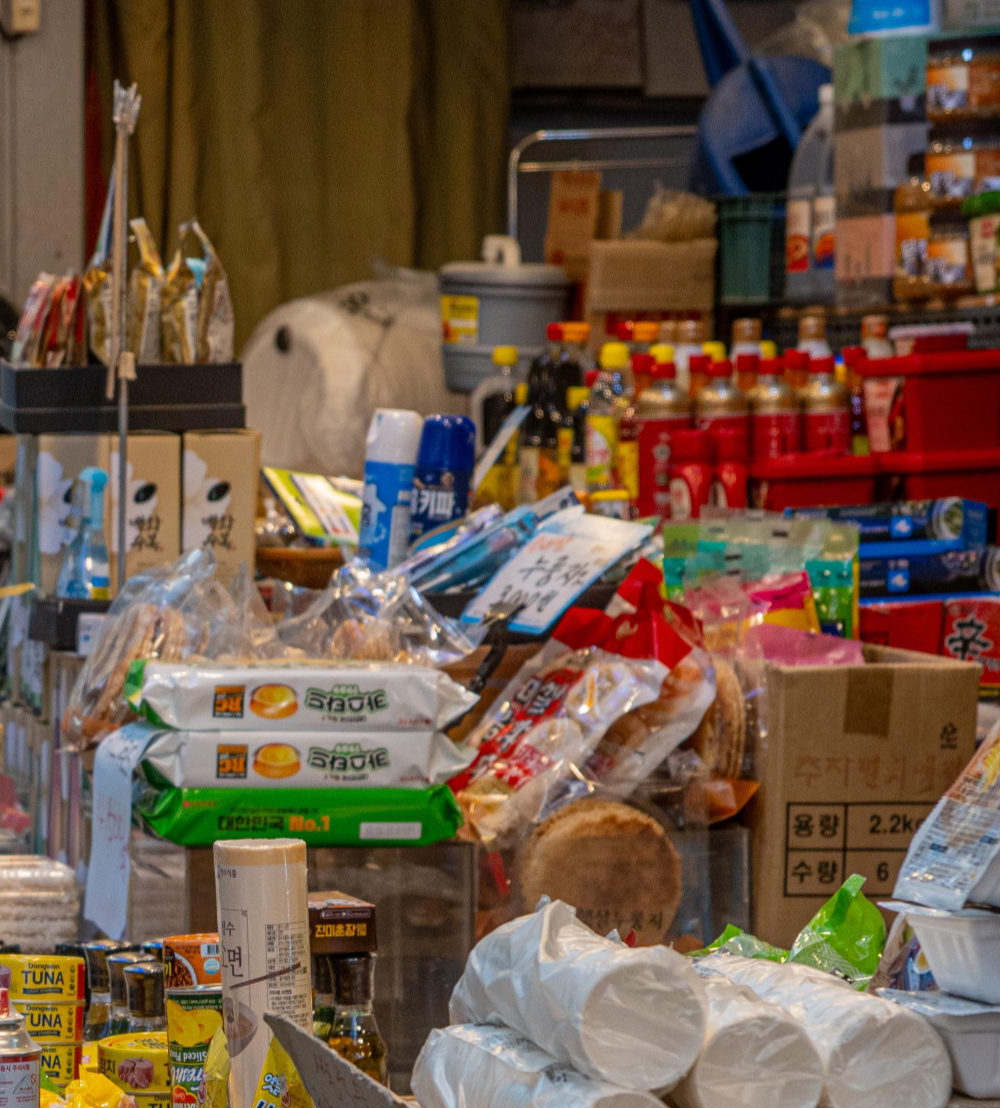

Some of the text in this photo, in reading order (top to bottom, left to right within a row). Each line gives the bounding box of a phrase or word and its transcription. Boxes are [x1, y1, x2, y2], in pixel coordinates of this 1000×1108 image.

[217, 815, 331, 832] 대한민국 No.1
[794, 813, 926, 838] 용량 2.2k
[791, 862, 889, 884] 수량 6
[27, 962, 61, 971] Dongwon
[21, 970, 65, 986] TUNA
[26, 1004, 59, 1013] Dongwon
[23, 1013, 63, 1028] TUNA
[41, 1055, 62, 1069] NA
